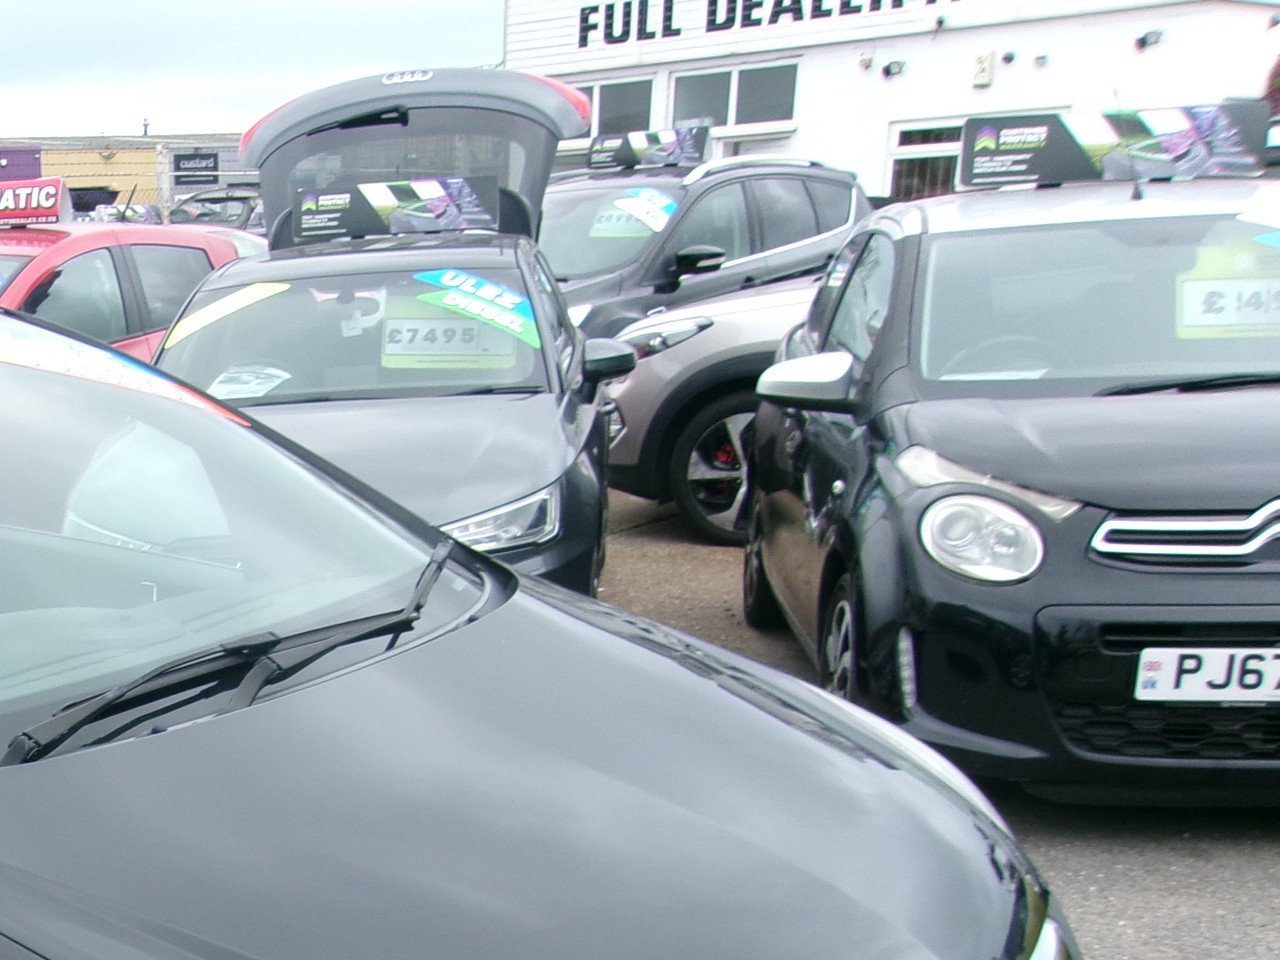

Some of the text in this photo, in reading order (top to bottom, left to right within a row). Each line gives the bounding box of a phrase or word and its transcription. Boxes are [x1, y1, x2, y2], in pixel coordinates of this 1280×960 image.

[578, 0, 904, 48] FULL DEA
[439, 270, 524, 310] ULEZ
[441, 291, 525, 334] DIESEL
[386, 327, 476, 344] £7495
